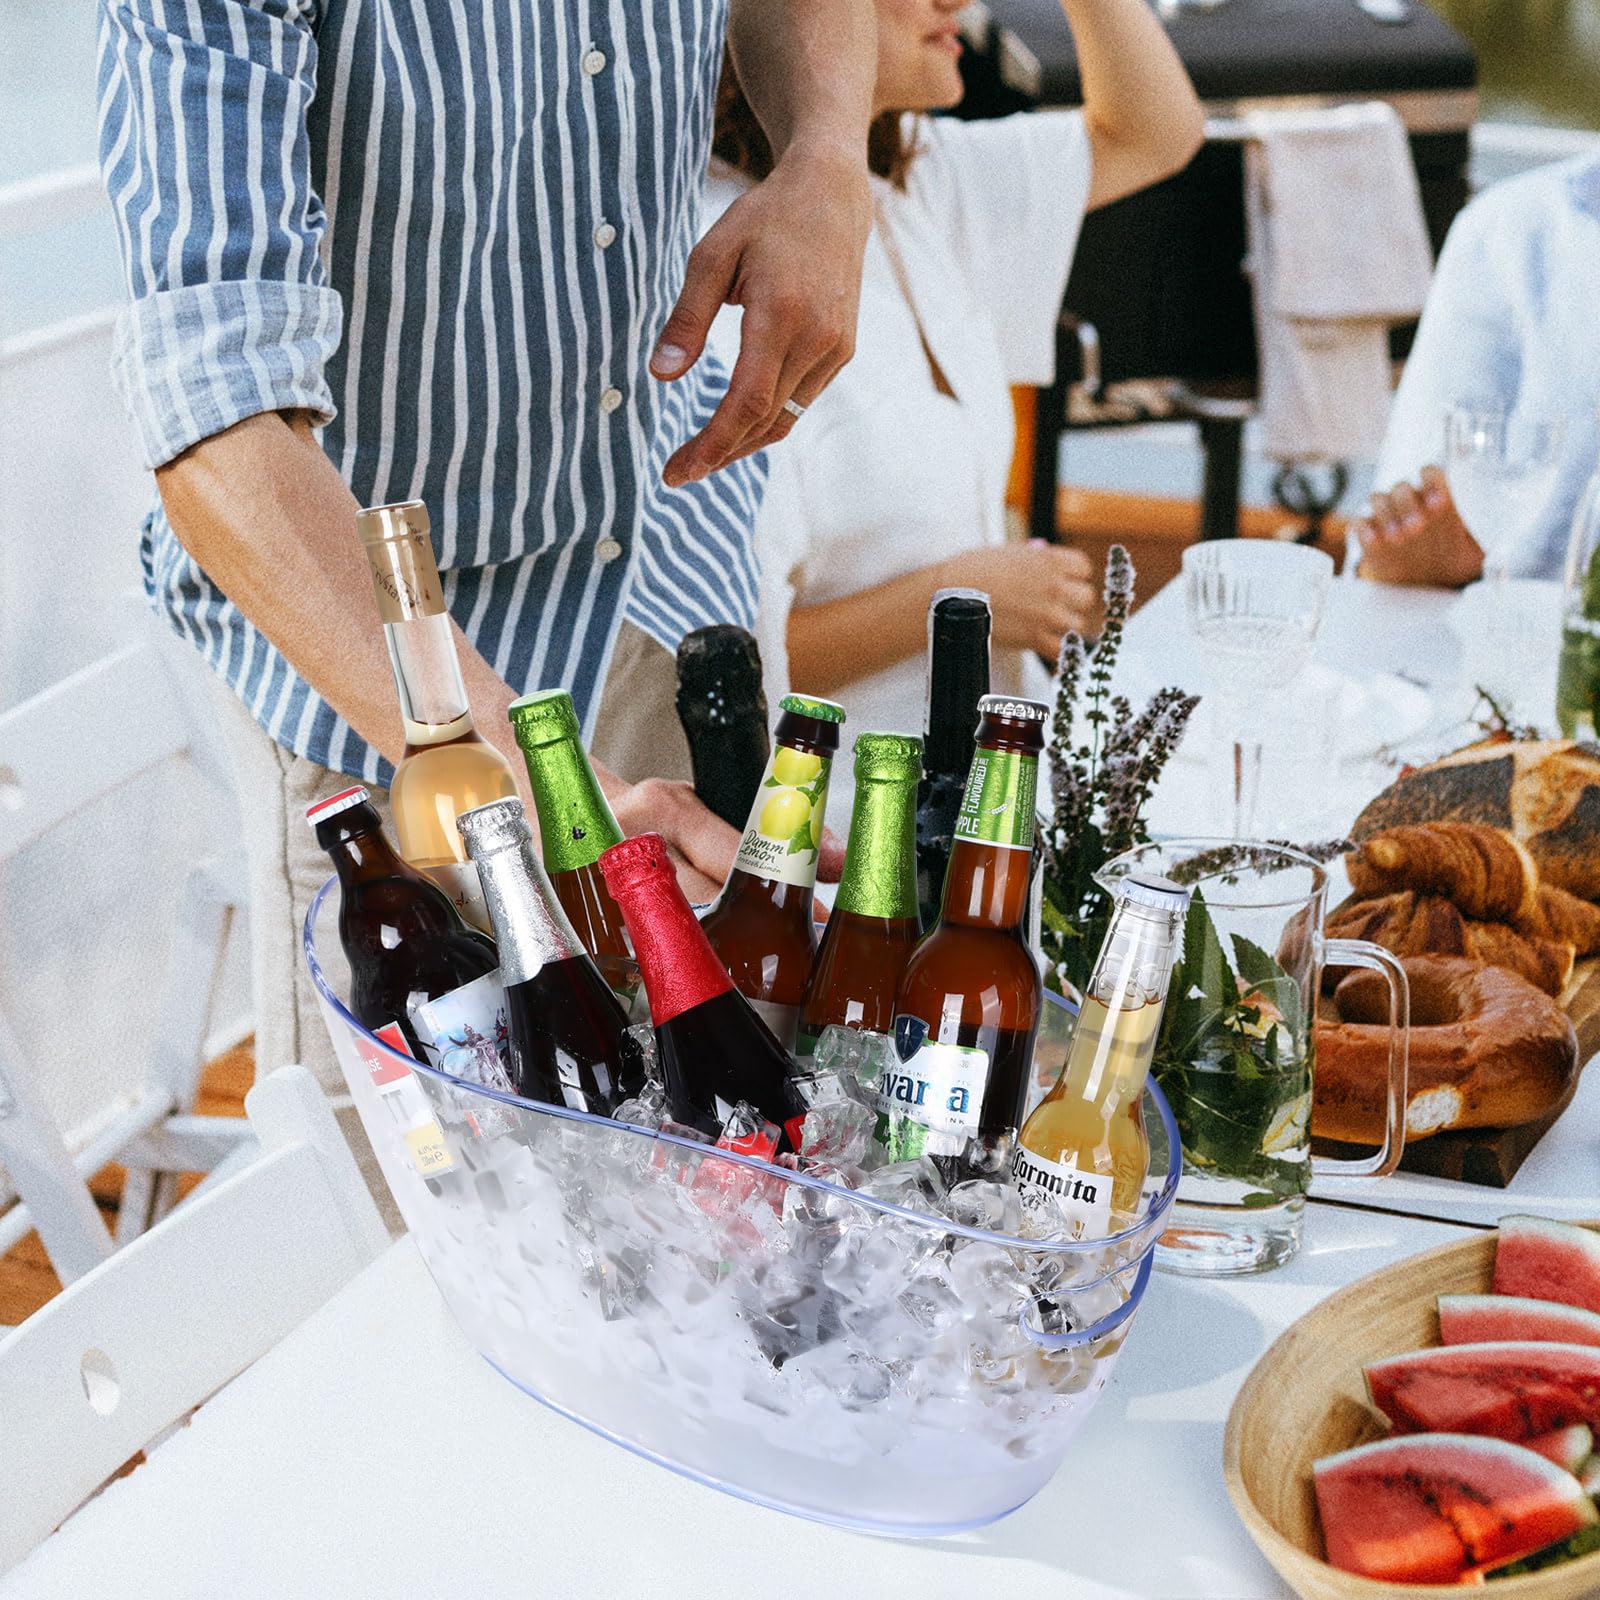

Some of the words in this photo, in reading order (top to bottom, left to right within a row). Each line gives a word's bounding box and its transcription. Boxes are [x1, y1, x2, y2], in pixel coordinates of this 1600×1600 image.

[966, 765, 987, 814] FLAVOURED
[955, 815, 980, 835] PPLE
[740, 842, 776, 864] Lemon
[744, 829, 784, 855] Damm
[1012, 1147, 1098, 1205] Coronita
